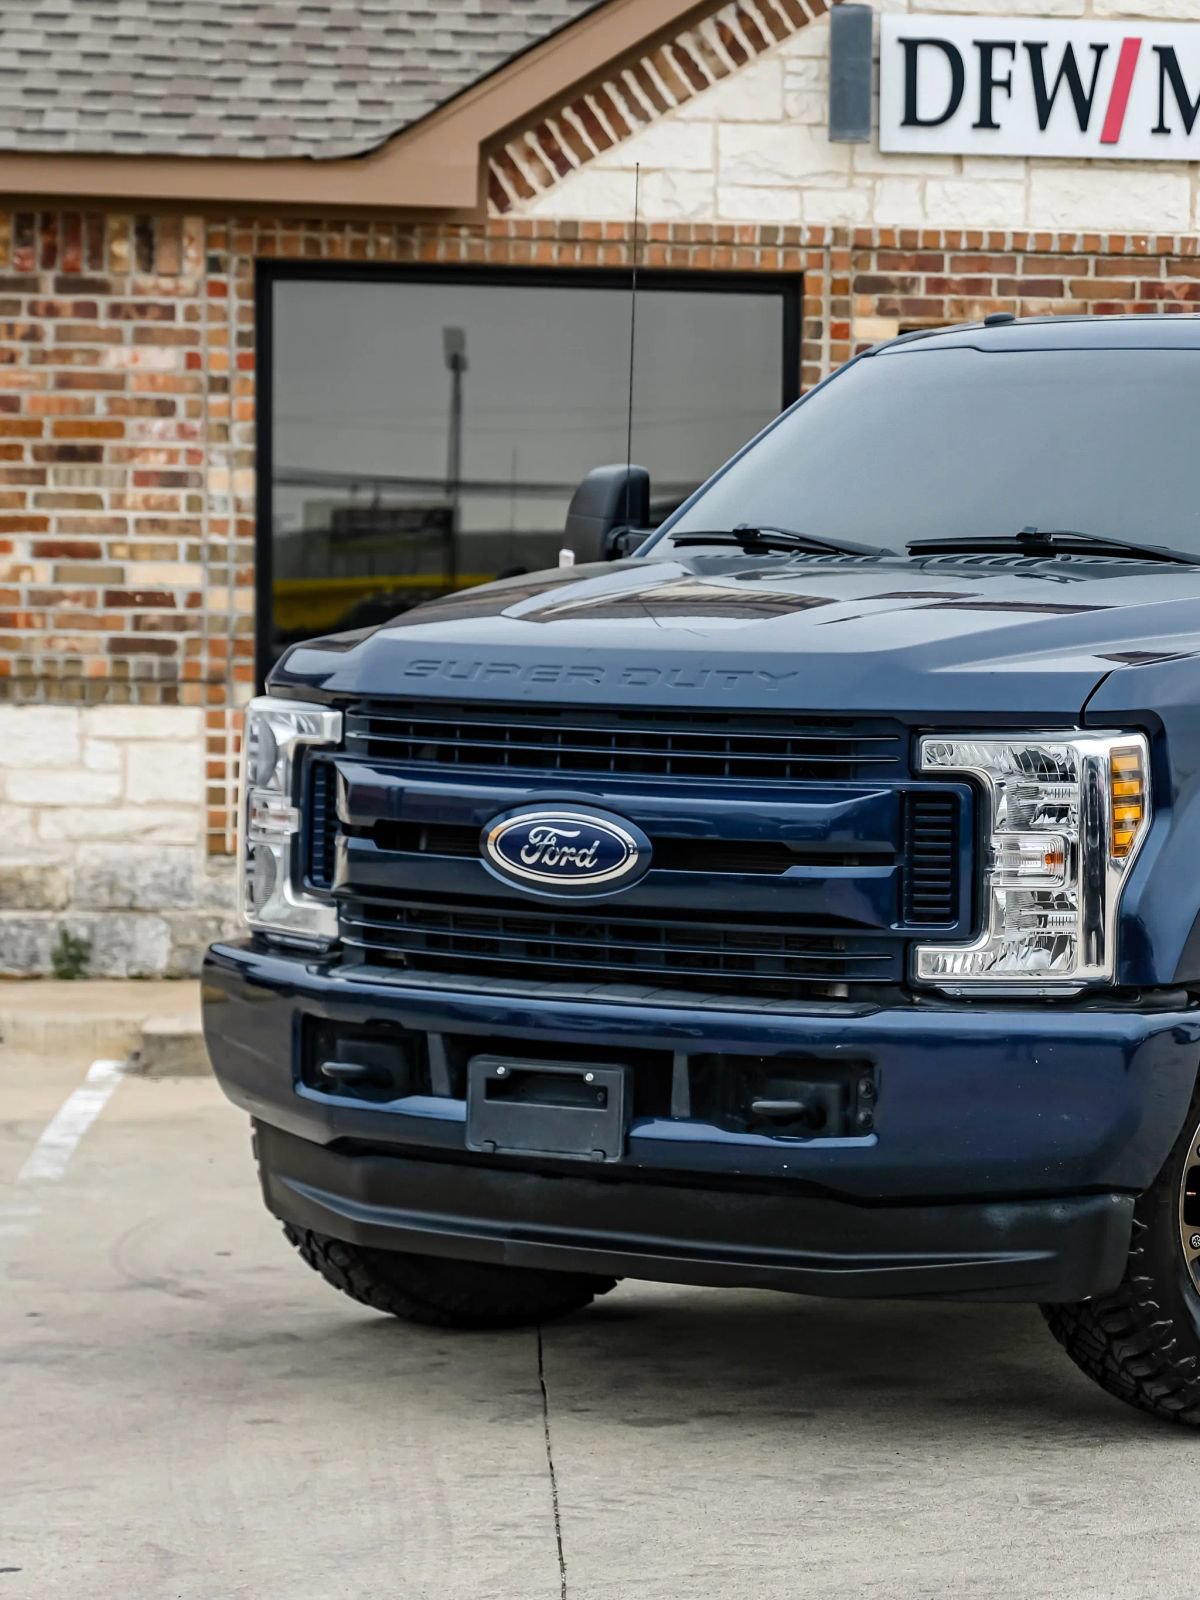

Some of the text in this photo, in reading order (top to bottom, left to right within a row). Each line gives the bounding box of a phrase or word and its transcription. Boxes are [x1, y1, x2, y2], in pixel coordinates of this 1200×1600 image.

[402, 658, 800, 691] SUPER DUTY
[520, 826, 600, 869] Ford
